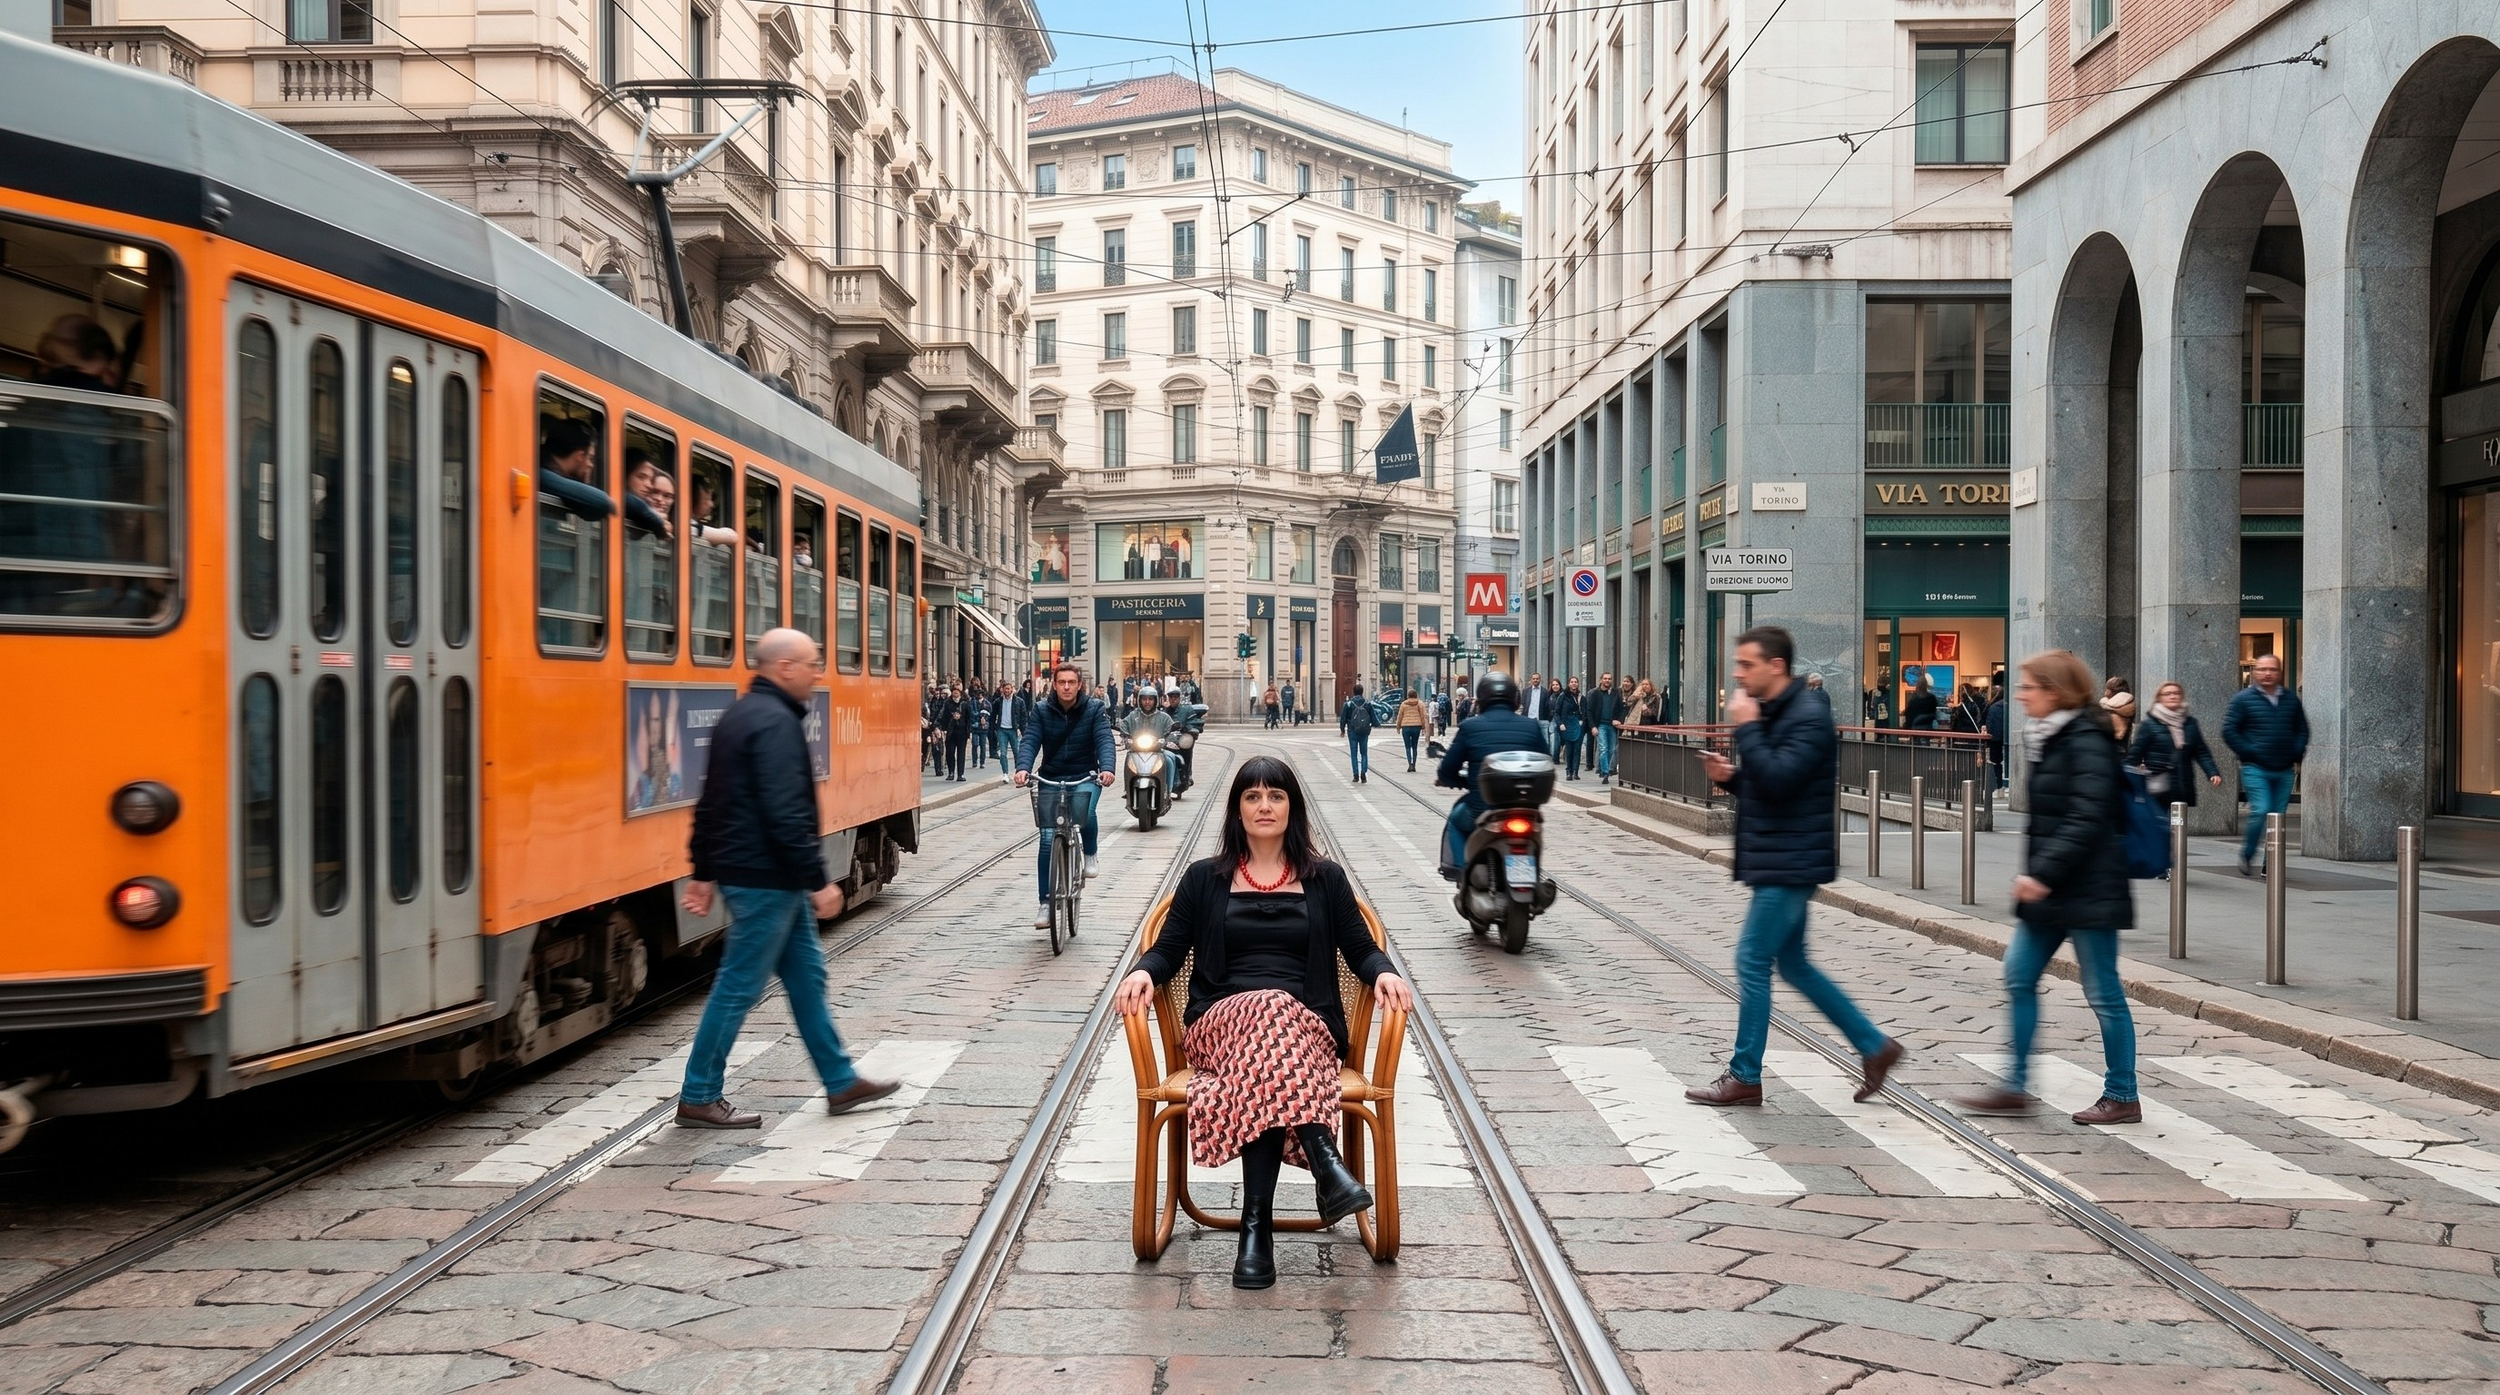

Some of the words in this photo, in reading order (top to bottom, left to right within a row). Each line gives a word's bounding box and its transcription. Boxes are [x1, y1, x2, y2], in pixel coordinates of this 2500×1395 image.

[1876, 484, 1928, 503] VIA
[1712, 554, 1732, 564] VIA
[1739, 554, 1787, 564] TORINO
[1757, 576, 1789, 584] DUOMO
[1469, 583, 1503, 606] M
[1111, 598, 1186, 609] PASTICCERIA
